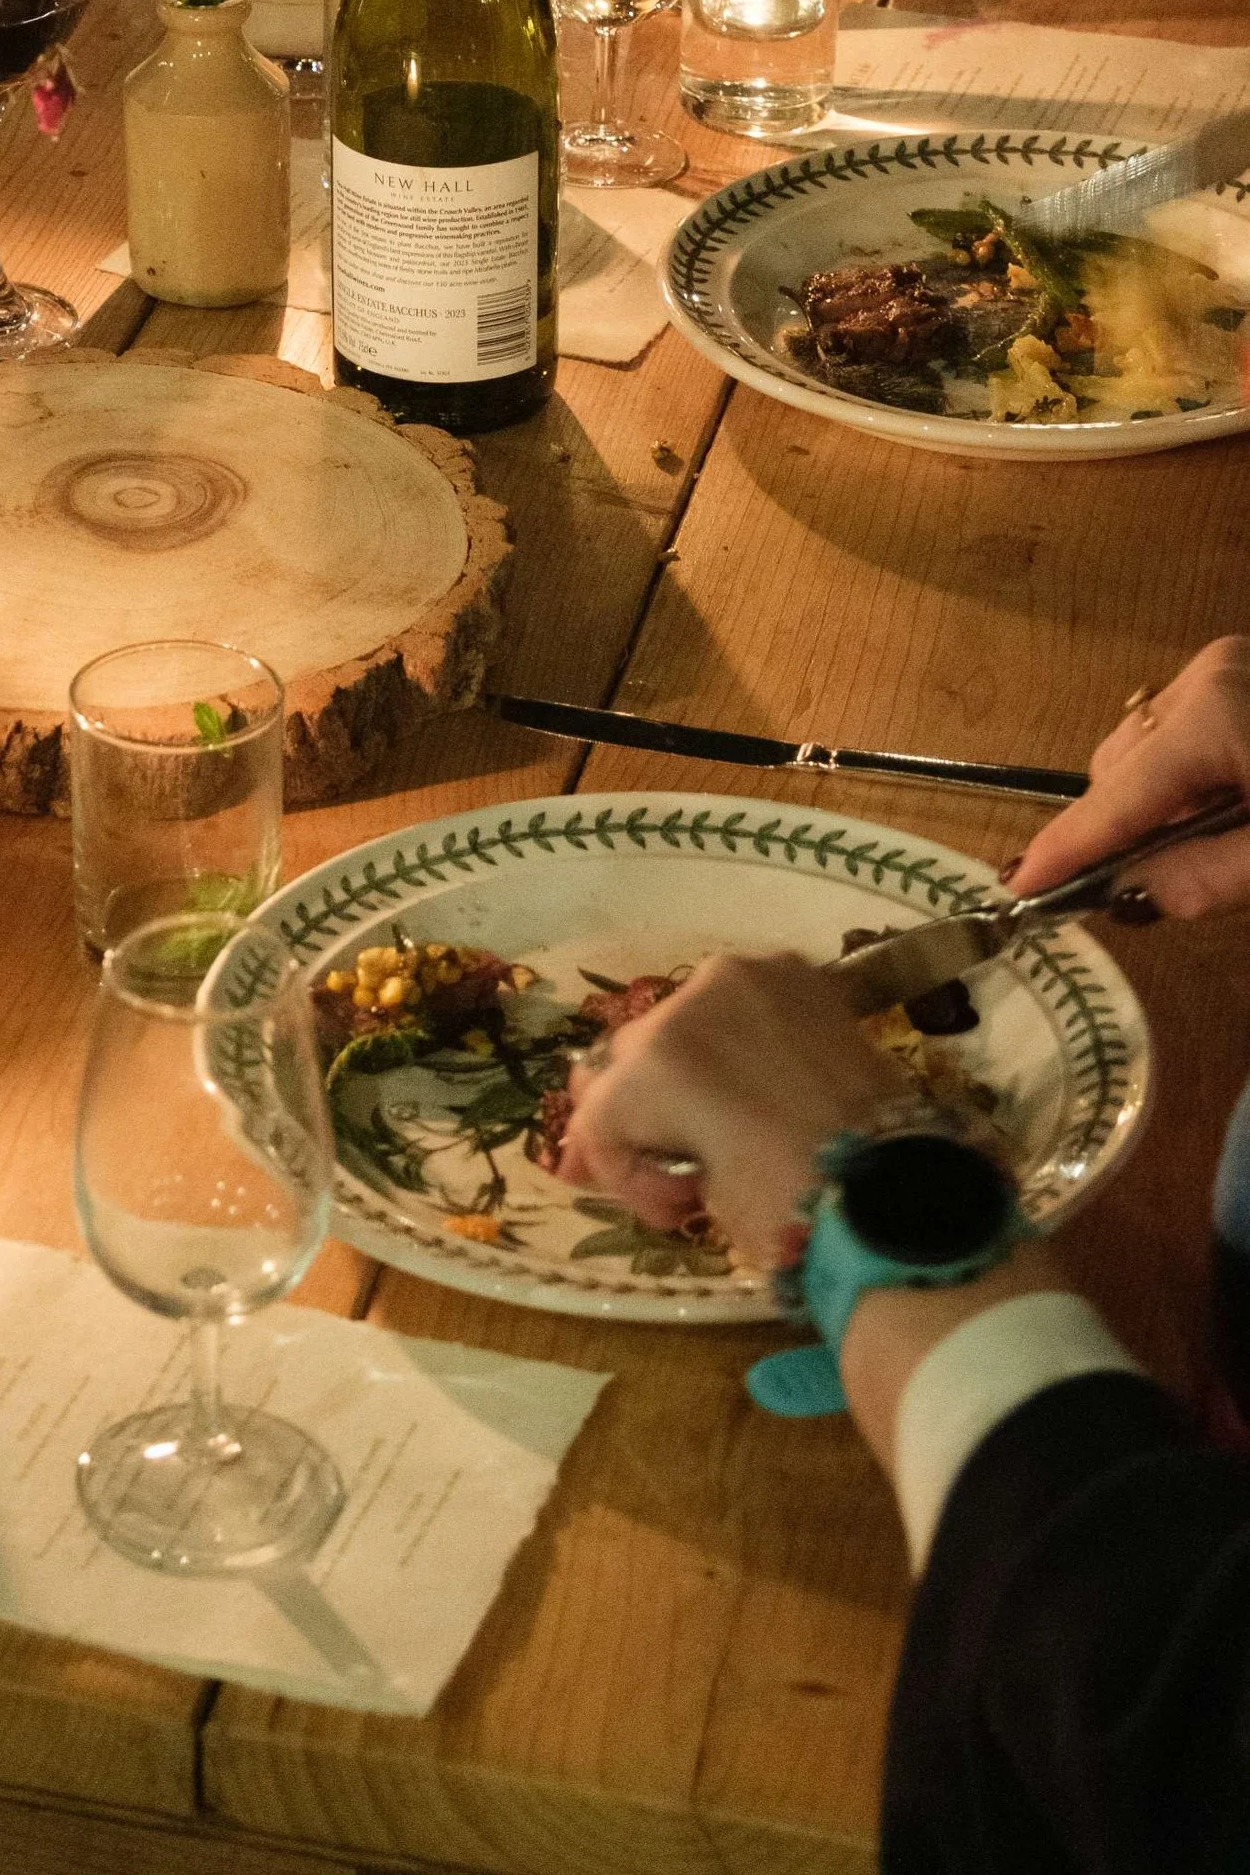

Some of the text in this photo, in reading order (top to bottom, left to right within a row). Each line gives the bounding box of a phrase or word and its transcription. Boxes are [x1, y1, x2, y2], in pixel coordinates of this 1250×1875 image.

[375, 173, 474, 192] NEW HALL
[391, 192, 413, 200] WINE
[383, 202, 405, 211] situated
[381, 210, 398, 219] region
[476, 211, 507, 221] Established
[480, 220, 504, 229] combine
[366, 222, 385, 232] modern
[398, 231, 432, 240] progressive
[357, 293, 387, 311] ESTATE
[389, 304, 437, 318] BACCHUS
[445, 309, 465, 318] 2023
[367, 309, 399, 323] ENGLAND
